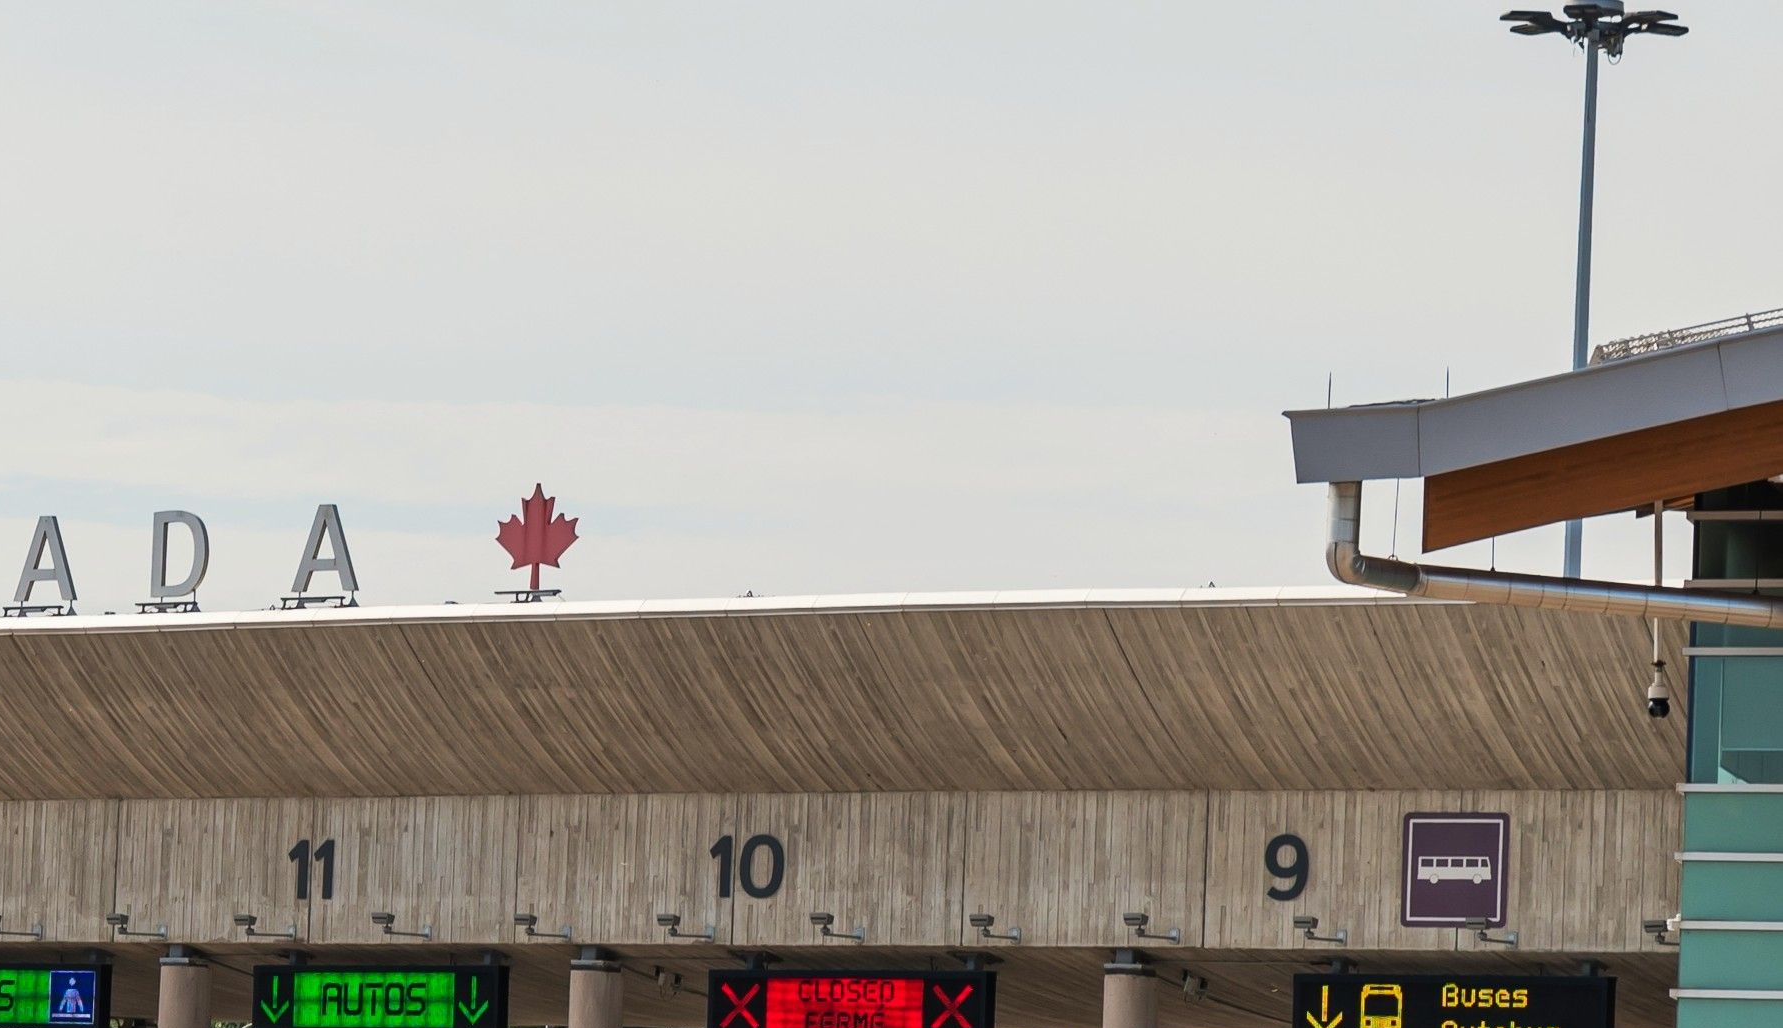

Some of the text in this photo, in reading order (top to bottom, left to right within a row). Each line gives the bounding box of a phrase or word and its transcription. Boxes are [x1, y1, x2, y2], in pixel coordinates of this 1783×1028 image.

[288, 839, 335, 900] 11
[710, 834, 785, 899] 10
[1264, 834, 1310, 901] 9
[321, 982, 427, 1017] AUTOS
[798, 979, 895, 1003] CLOSED
[1441, 983, 1528, 1008] Buses
